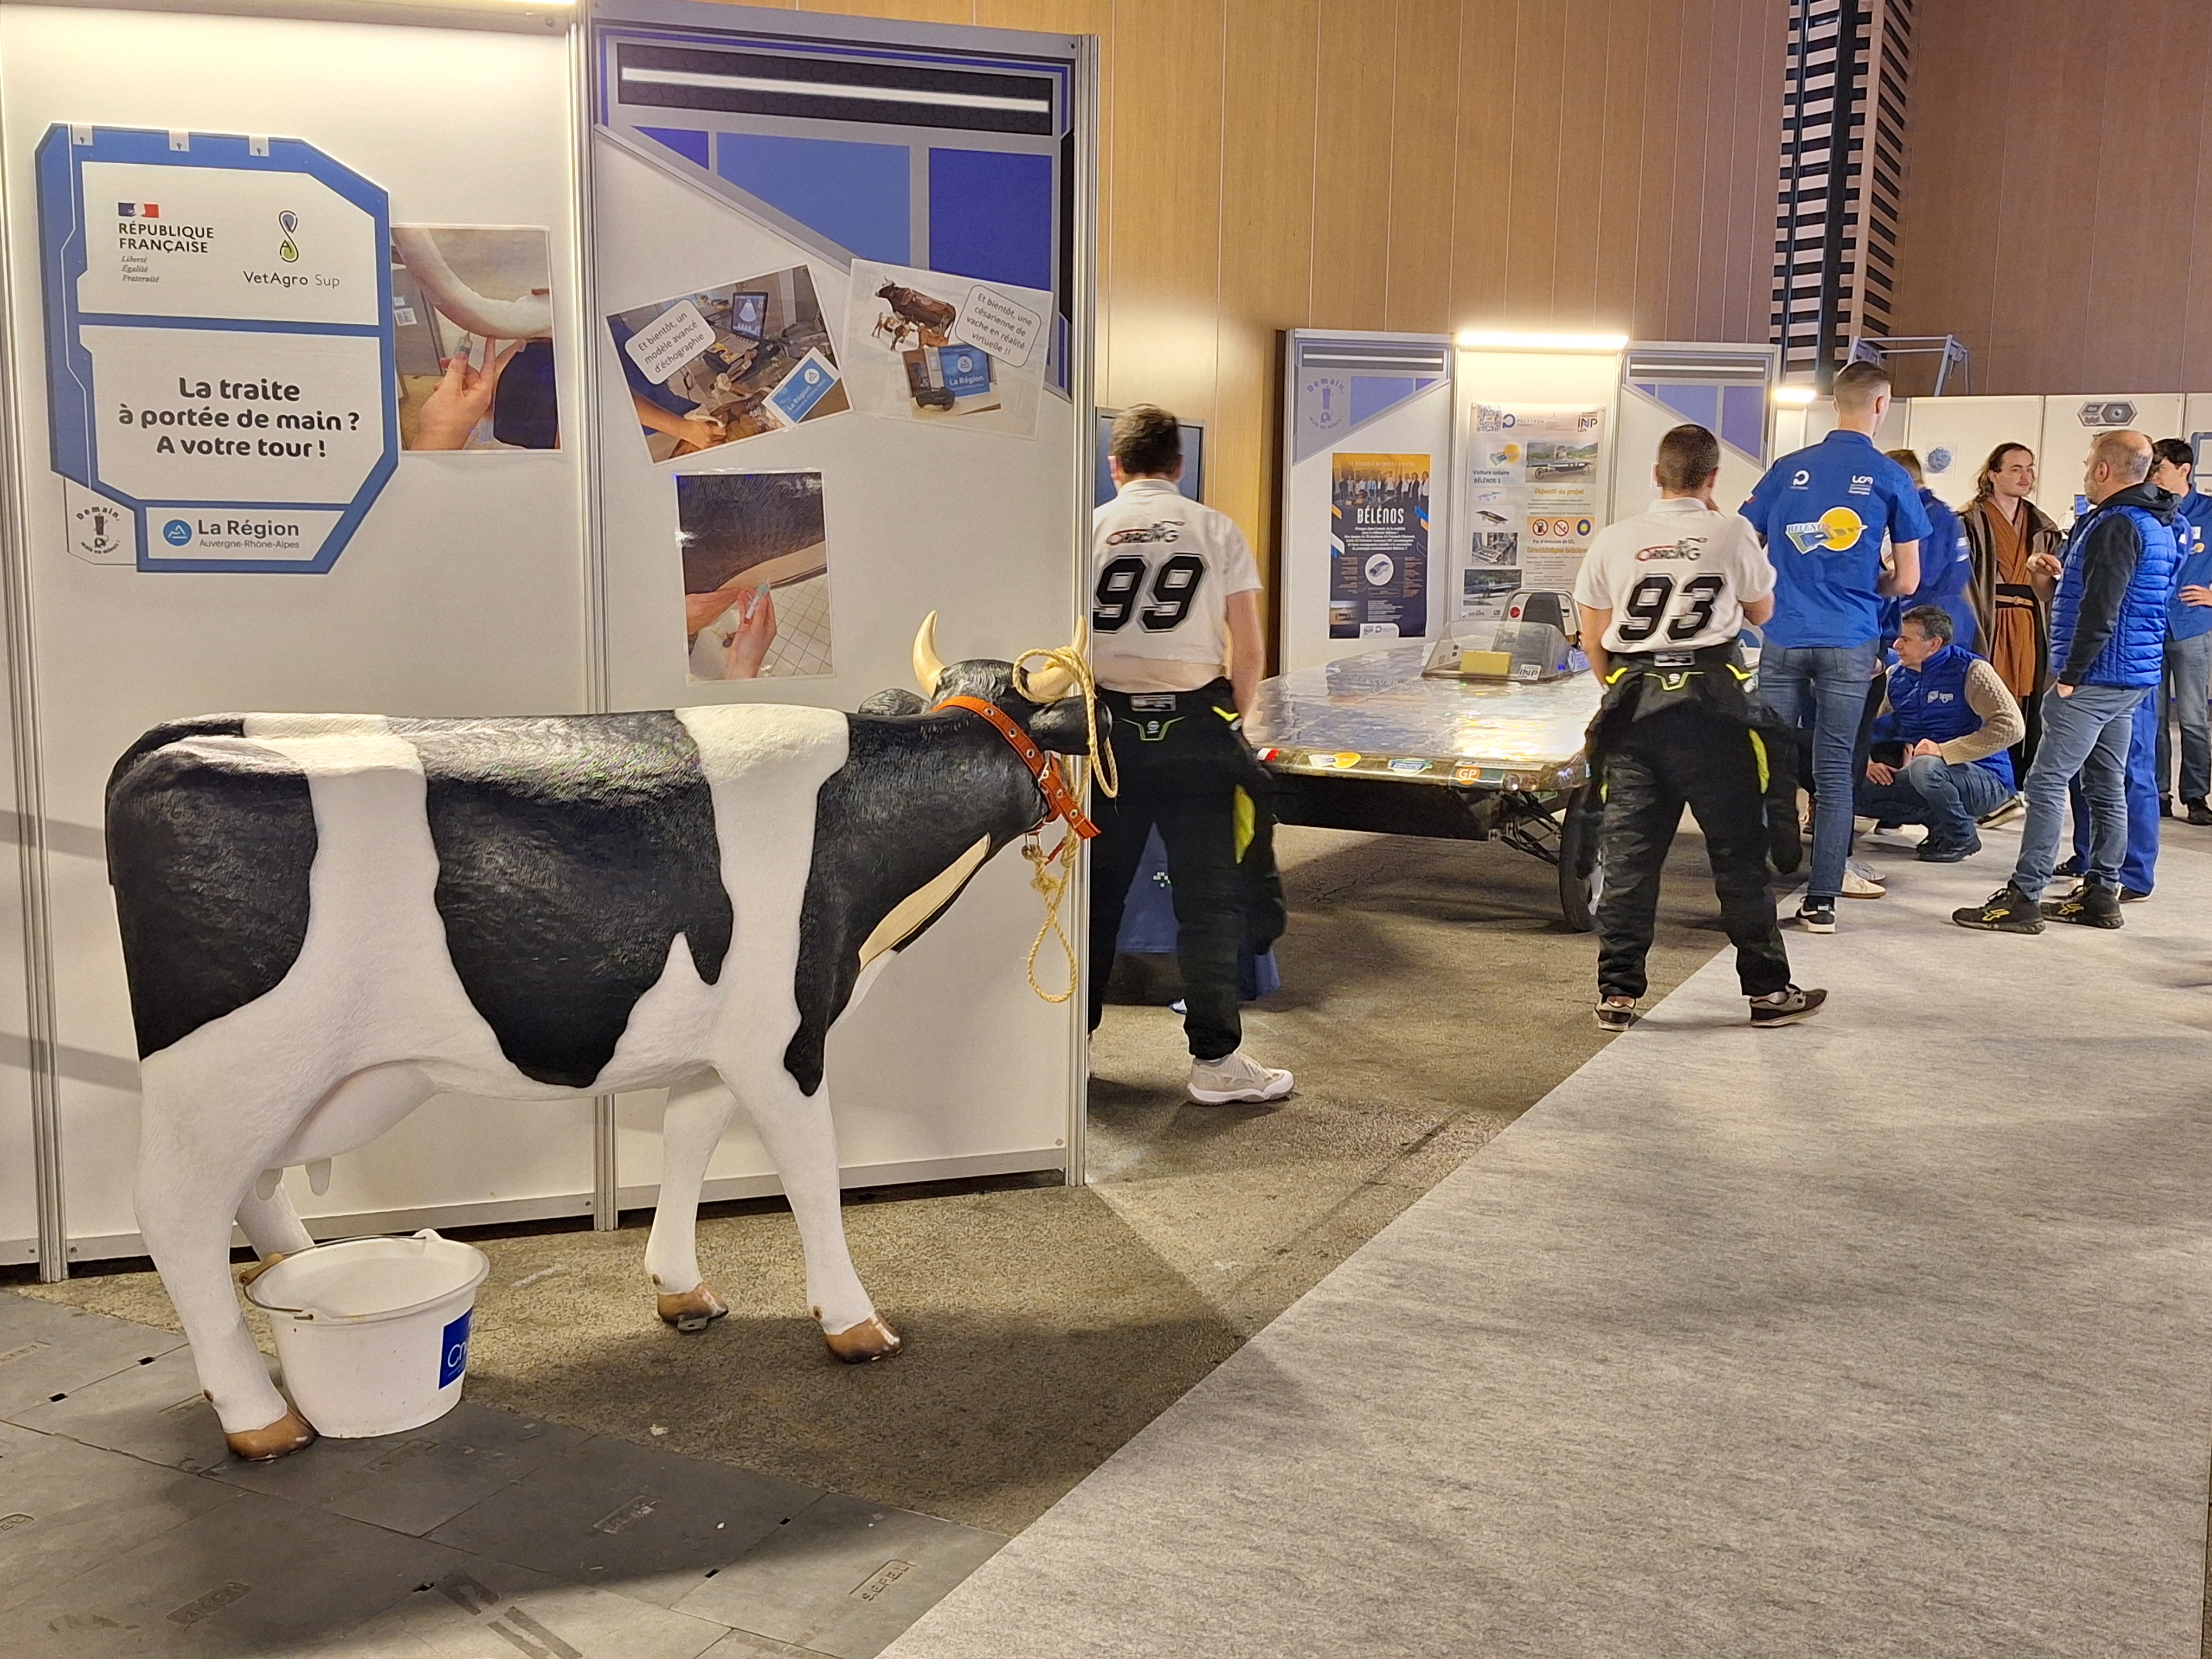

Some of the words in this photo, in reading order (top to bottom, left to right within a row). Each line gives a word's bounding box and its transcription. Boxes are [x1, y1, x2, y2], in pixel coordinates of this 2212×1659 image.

[118, 221, 214, 240] RÉPUBLIQUE
[119, 237, 208, 253] FRANÇAISE
[121, 255, 147, 263] Liberté
[121, 264, 148, 273] Égalité
[122, 275, 160, 284] Fraternité
[243, 271, 308, 288] VetAgro
[314, 274, 340, 290] Sup
[978, 293, 986, 303] Et
[987, 298, 1015, 319] bientôt,
[1018, 315, 1032, 326] une
[638, 342, 648, 351] Et
[646, 321, 678, 345] bientôt,
[677, 313, 688, 324] un
[974, 307, 1015, 331] césarienne
[1016, 327, 1026, 337] de
[645, 340, 673, 364] modèle
[672, 320, 698, 343] avancé
[967, 316, 989, 331] vache
[990, 329, 999, 337] en
[1001, 335, 1025, 350] réalité
[972, 332, 1002, 352] virtuelle
[654, 333, 705, 374] d'échographie
[179, 377, 212, 398] La
[220, 378, 300, 402] traite
[959, 375, 984, 384] Région
[119, 403, 133, 425] à
[141, 406, 230, 429] portée
[236, 409, 269, 428] de
[276, 410, 342, 431] main
[156, 435, 176, 454] A
[181, 437, 250, 456] votre
[258, 438, 313, 458] tour
[198, 519, 221, 535] La
[227, 519, 299, 539] Région
[199, 539, 299, 550] Auvergne-Rhône-Alpes
[1093, 552, 1210, 633] 99
[1617, 573, 1727, 644] 93
[1458, 769, 1477, 779] GP
